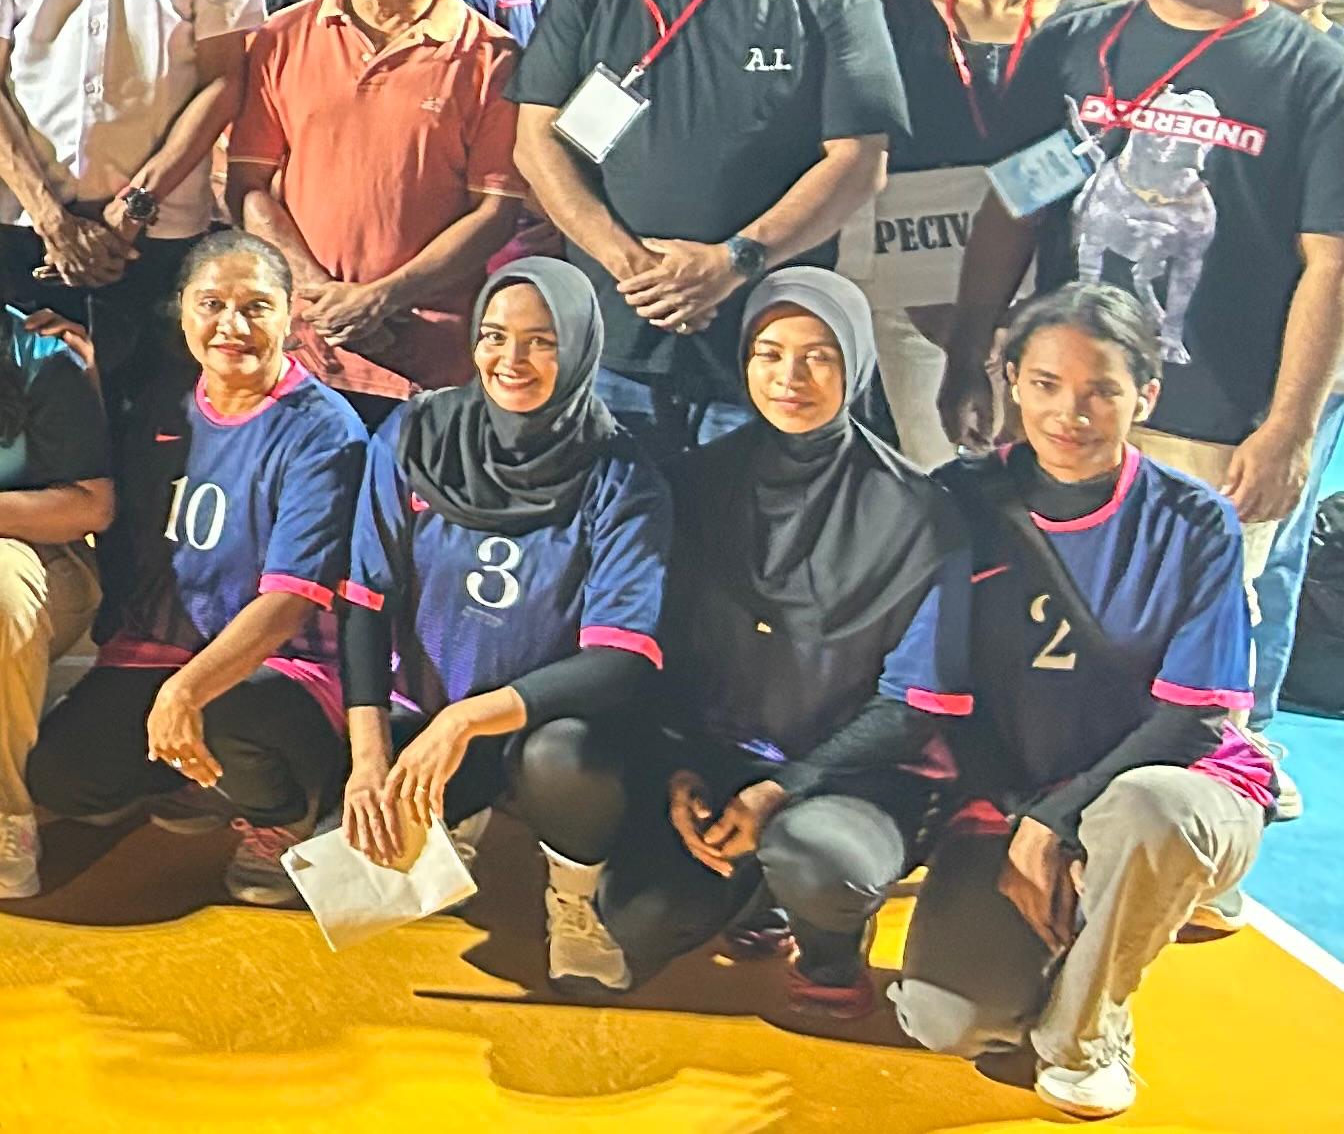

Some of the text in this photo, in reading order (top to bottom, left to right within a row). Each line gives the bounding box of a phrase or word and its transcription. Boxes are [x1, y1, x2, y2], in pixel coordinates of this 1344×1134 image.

[164, 475, 227, 551] 10
[466, 536, 520, 610] 3
[1030, 594, 1076, 670] 2
